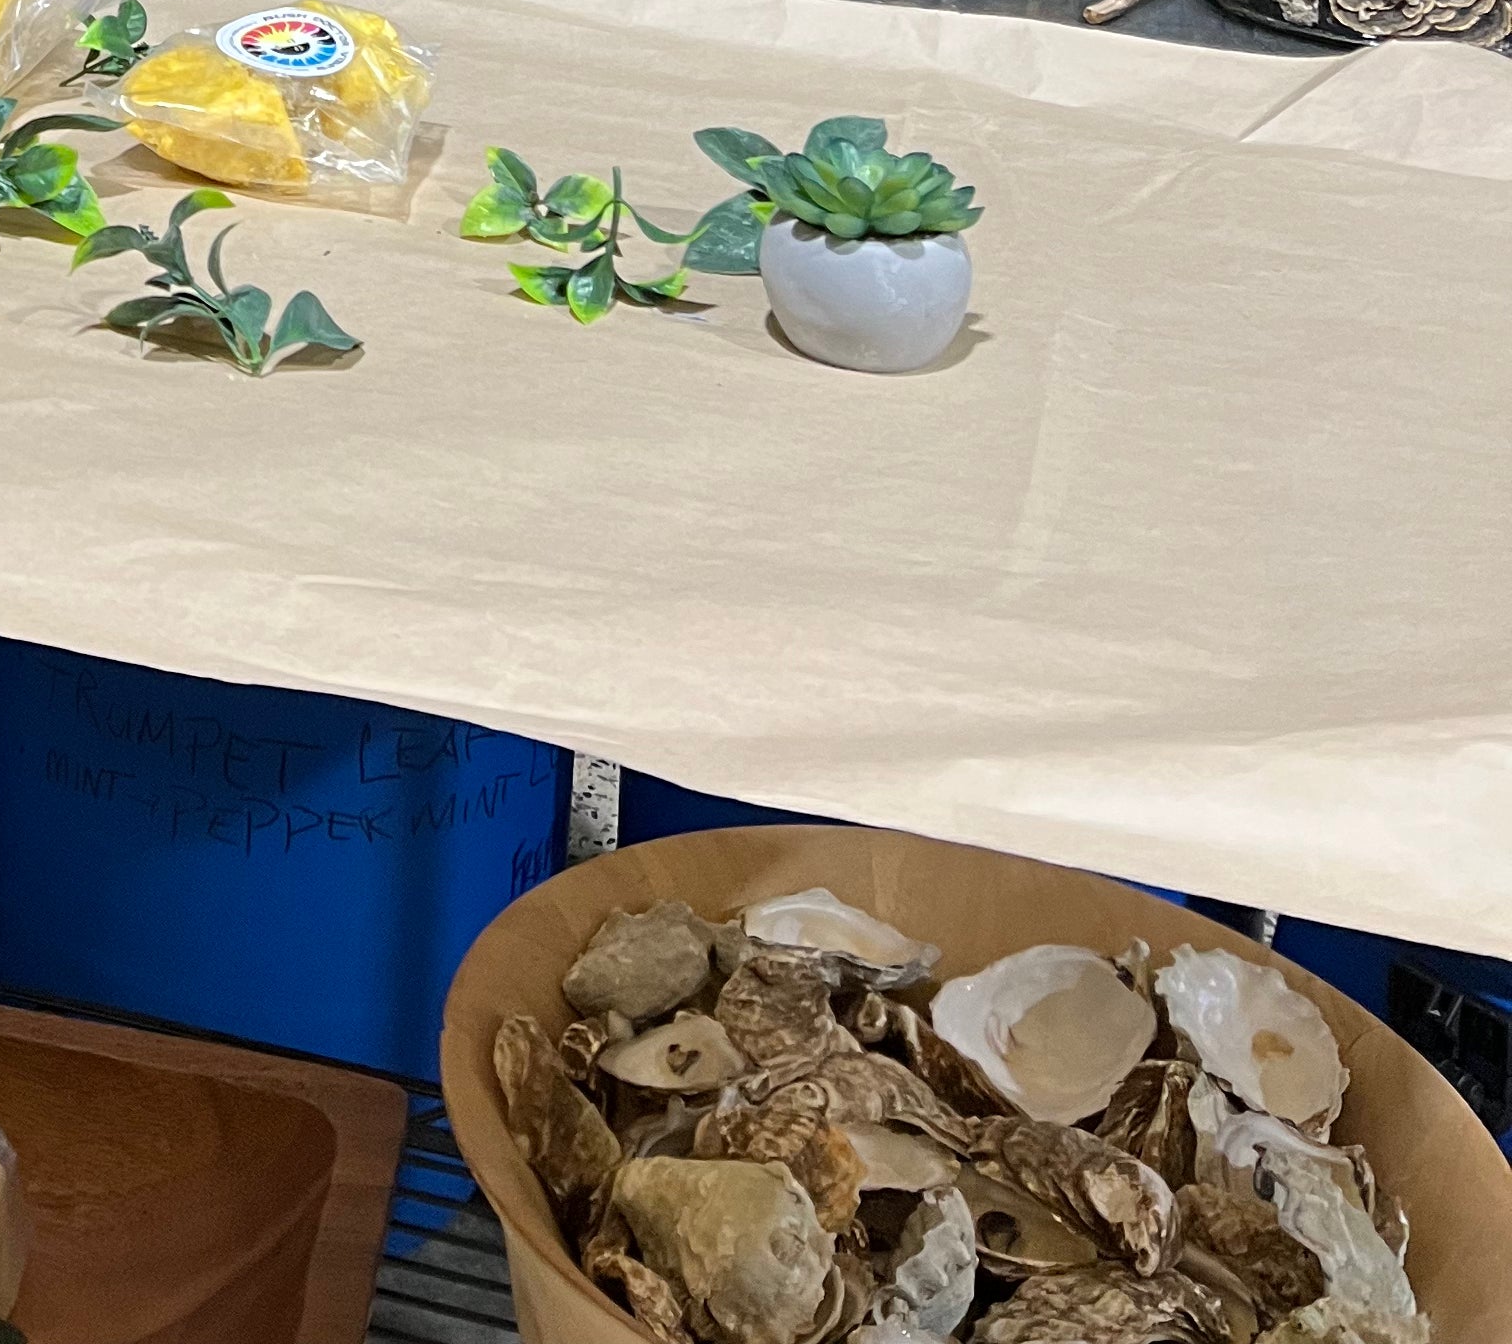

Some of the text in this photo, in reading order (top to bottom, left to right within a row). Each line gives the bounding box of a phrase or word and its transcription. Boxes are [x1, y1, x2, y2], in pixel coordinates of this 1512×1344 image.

[39, 657, 326, 794] TRUMPET
[357, 720, 500, 787] LEAF
[168, 777, 395, 860] PEPPER
[408, 770, 522, 839] MINT
